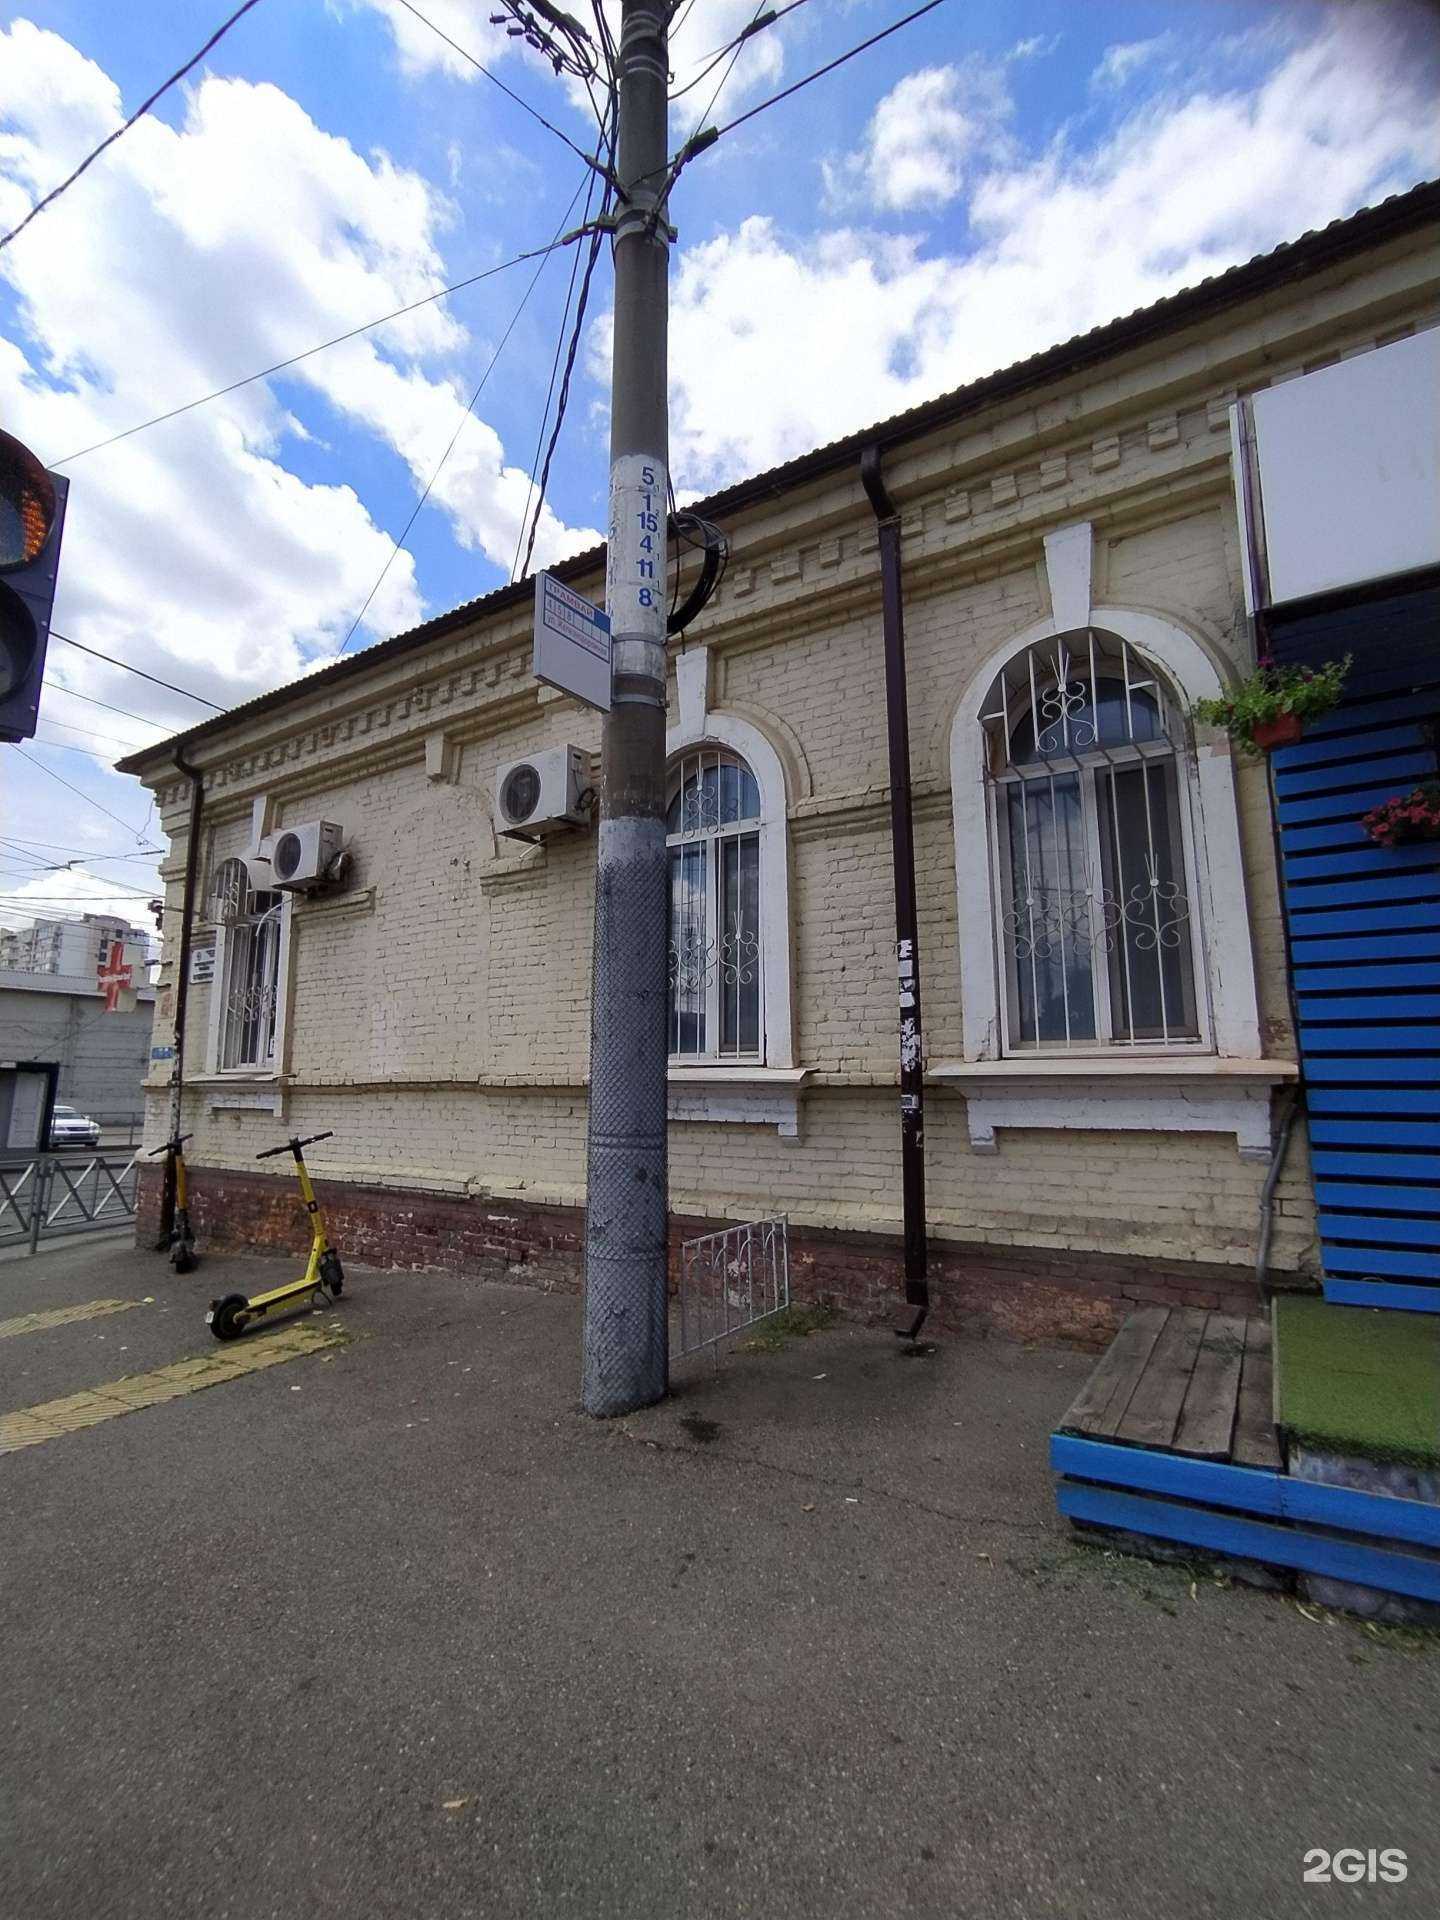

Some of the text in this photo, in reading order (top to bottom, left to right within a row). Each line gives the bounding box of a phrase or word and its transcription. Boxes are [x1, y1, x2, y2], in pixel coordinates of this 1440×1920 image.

[642, 466, 655, 485] 5
[642, 494, 651, 512] 1
[637, 511, 658, 533] 15
[640, 534, 653, 553] 4
[636, 558, 653, 579] 11
[639, 588, 653, 607] 8
